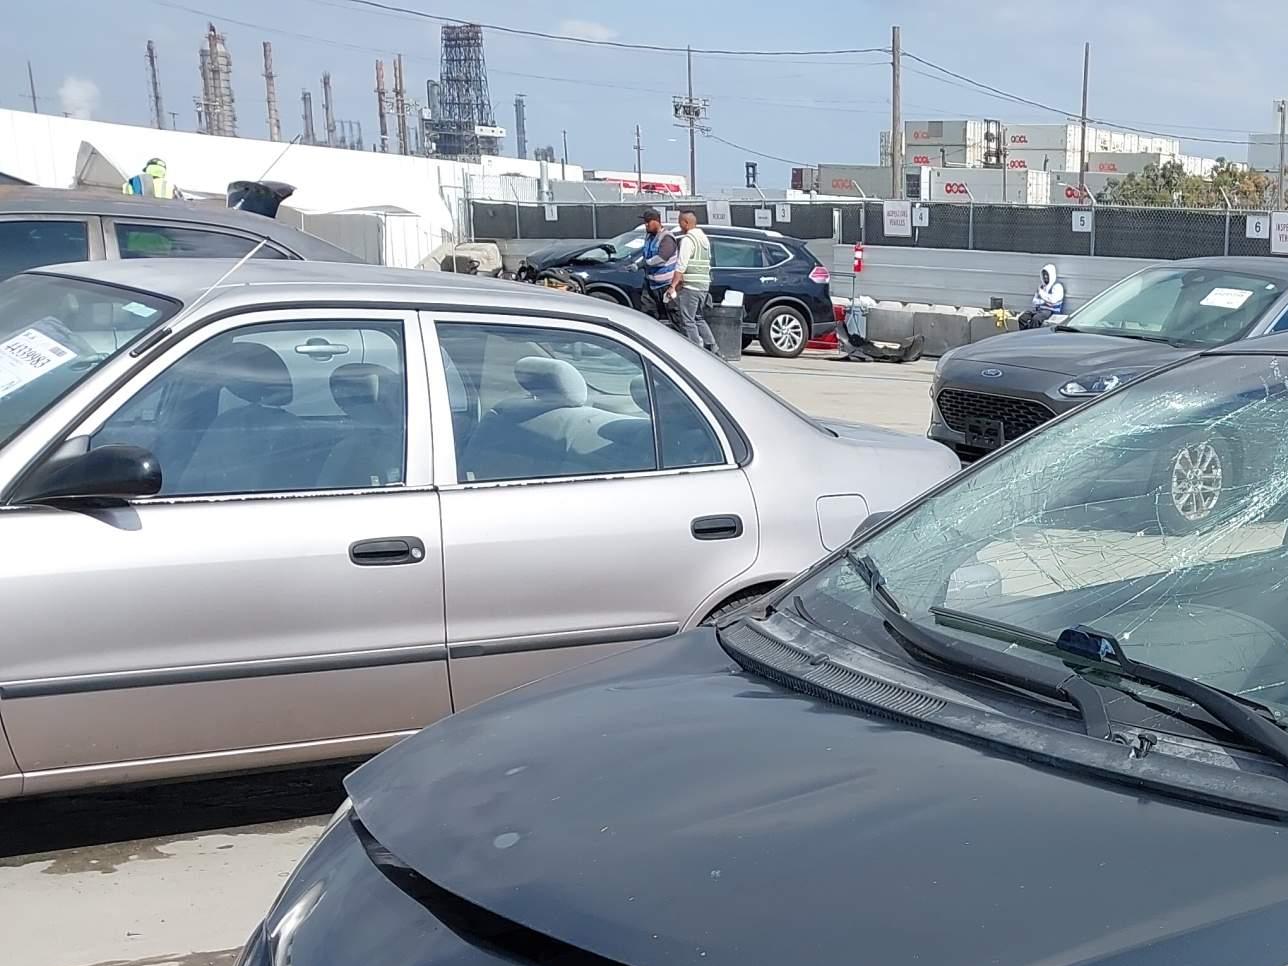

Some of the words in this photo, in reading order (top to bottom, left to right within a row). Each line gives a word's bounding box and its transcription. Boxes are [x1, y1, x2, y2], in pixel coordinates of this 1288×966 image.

[781, 208, 786, 217] 3
[1079, 216, 1086, 227] 5
[1254, 221, 1262, 233] 6
